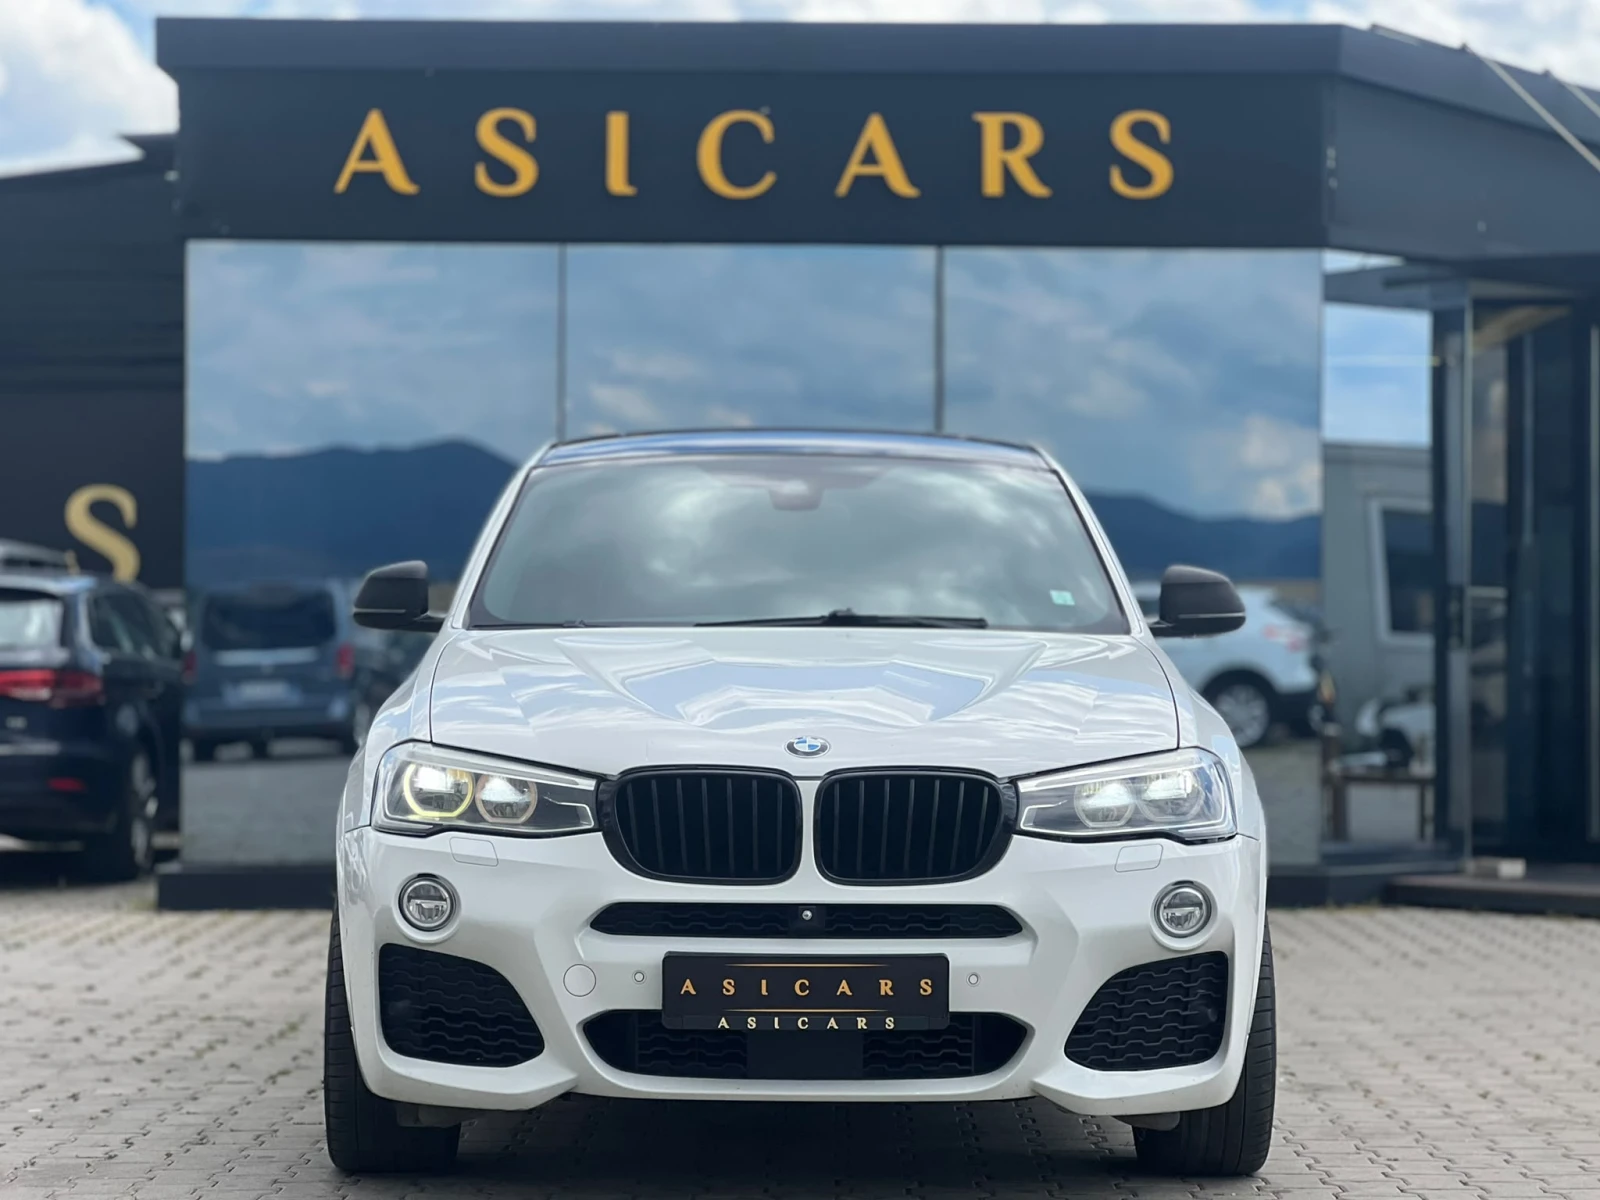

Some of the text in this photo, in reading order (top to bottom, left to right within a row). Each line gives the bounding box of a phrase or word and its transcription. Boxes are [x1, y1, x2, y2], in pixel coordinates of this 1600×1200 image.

[334, 107, 1175, 200] ASICARS
[680, 978, 933, 996] ASICARS
[717, 1016, 895, 1030] ASICARS
